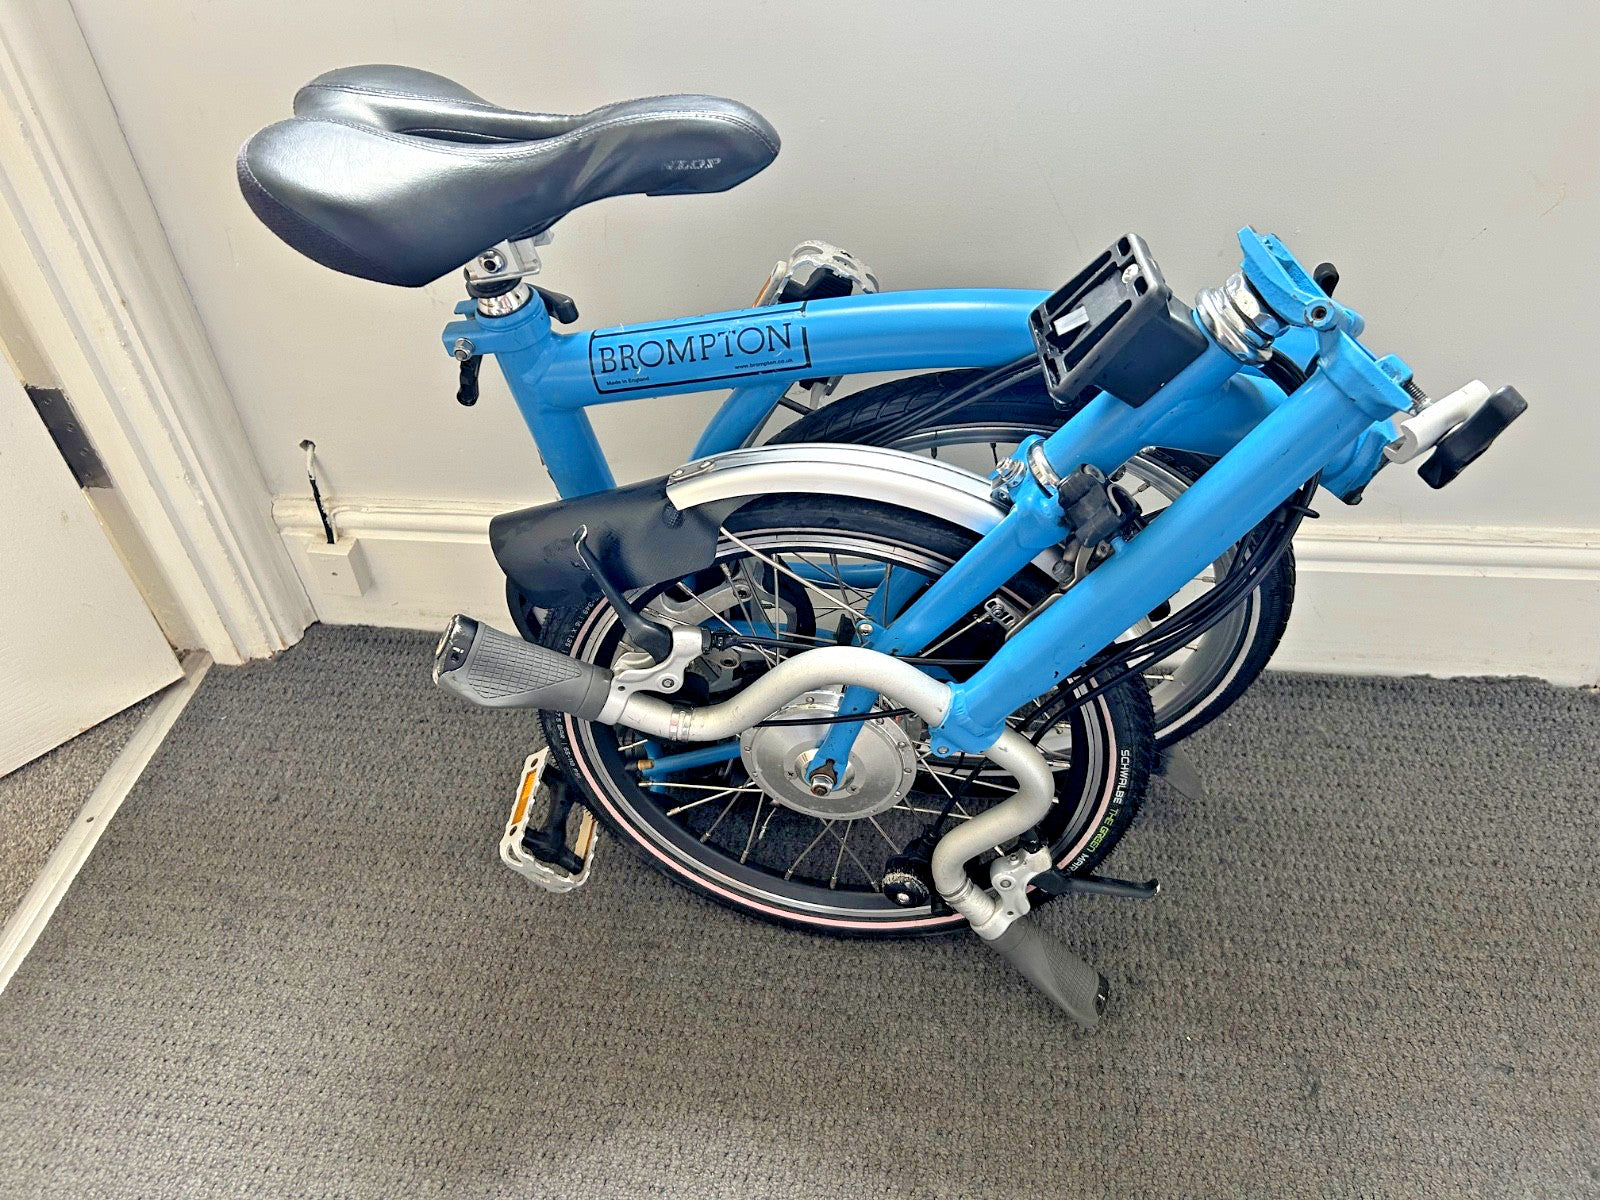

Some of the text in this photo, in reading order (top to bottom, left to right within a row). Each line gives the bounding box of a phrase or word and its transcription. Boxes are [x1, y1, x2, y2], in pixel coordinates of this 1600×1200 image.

[598, 323, 791, 374] BROMPTON
[734, 358, 794, 369] www.brompton.co.uk
[628, 376, 650, 384] England
[1067, 749, 1130, 871] SCHWALBE THE GREEN MAR
